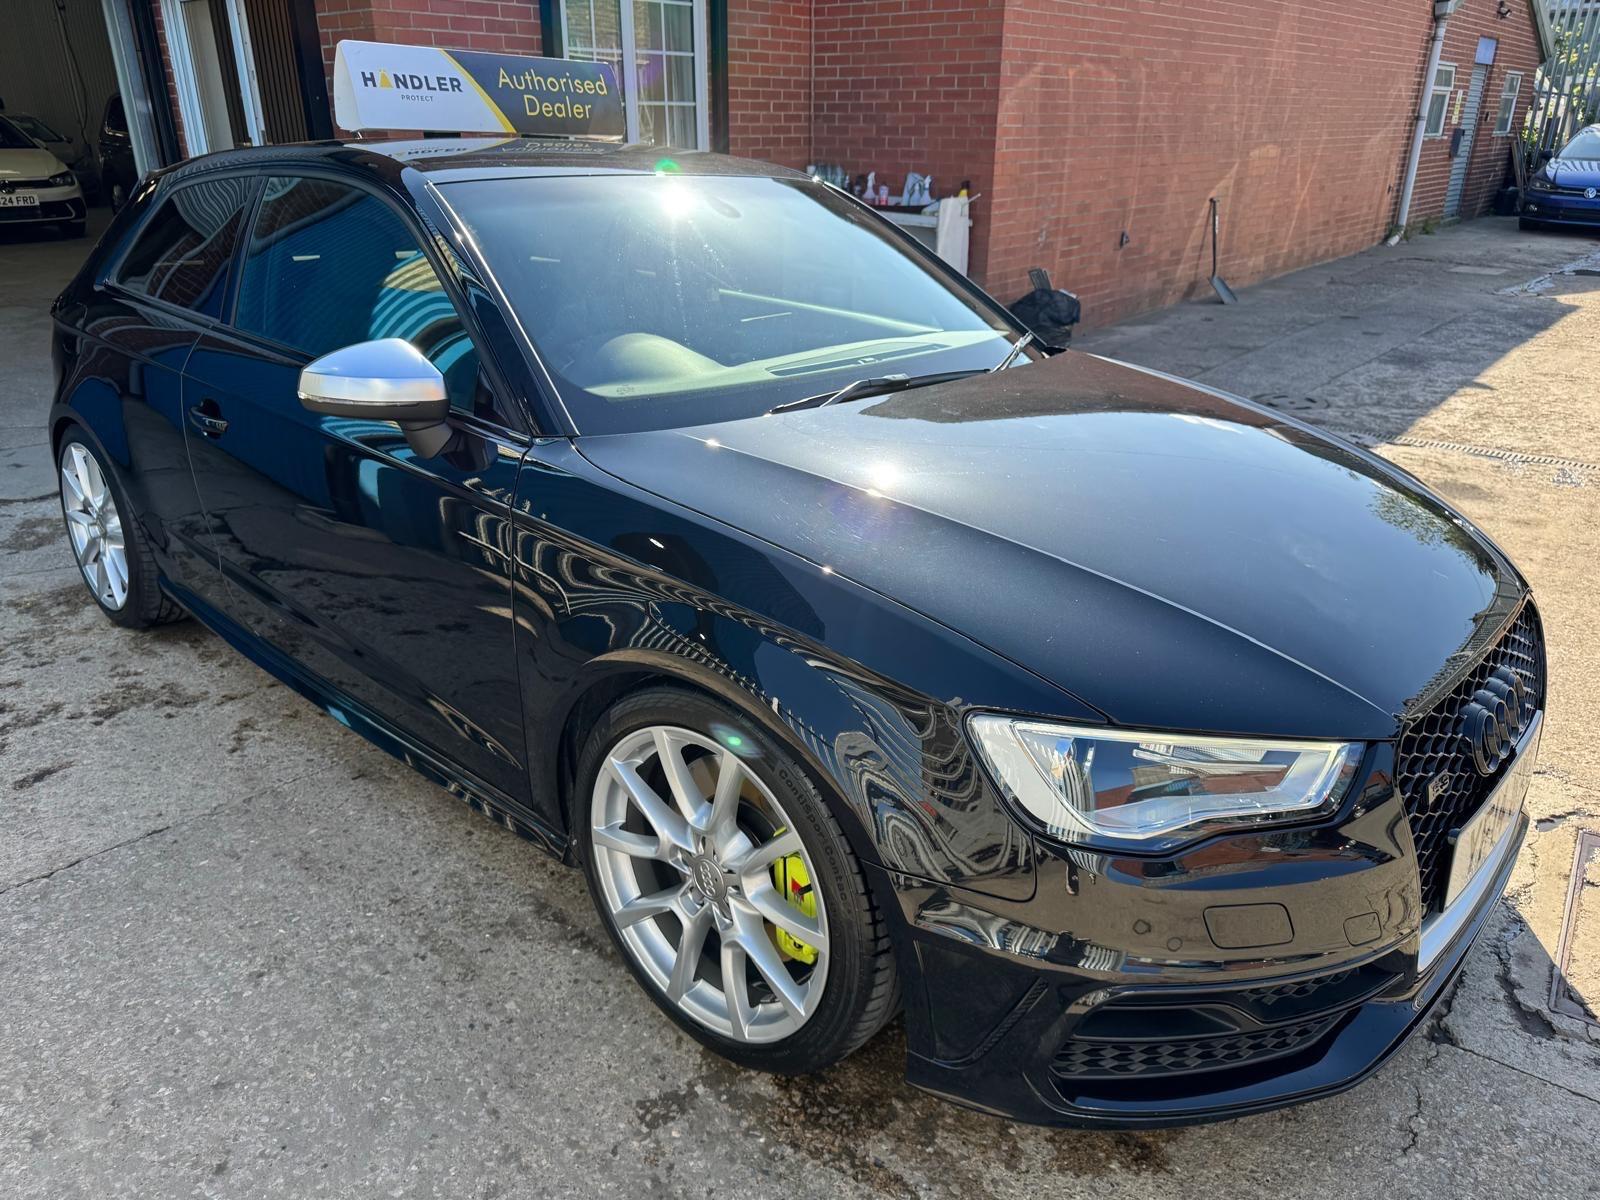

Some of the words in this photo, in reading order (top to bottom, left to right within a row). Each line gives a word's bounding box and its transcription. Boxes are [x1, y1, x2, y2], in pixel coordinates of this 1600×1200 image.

[499, 67, 607, 95] Authorised
[401, 94, 434, 102] PROTECT
[523, 94, 592, 119] Dealer
[15, 196, 35, 205] FRD
